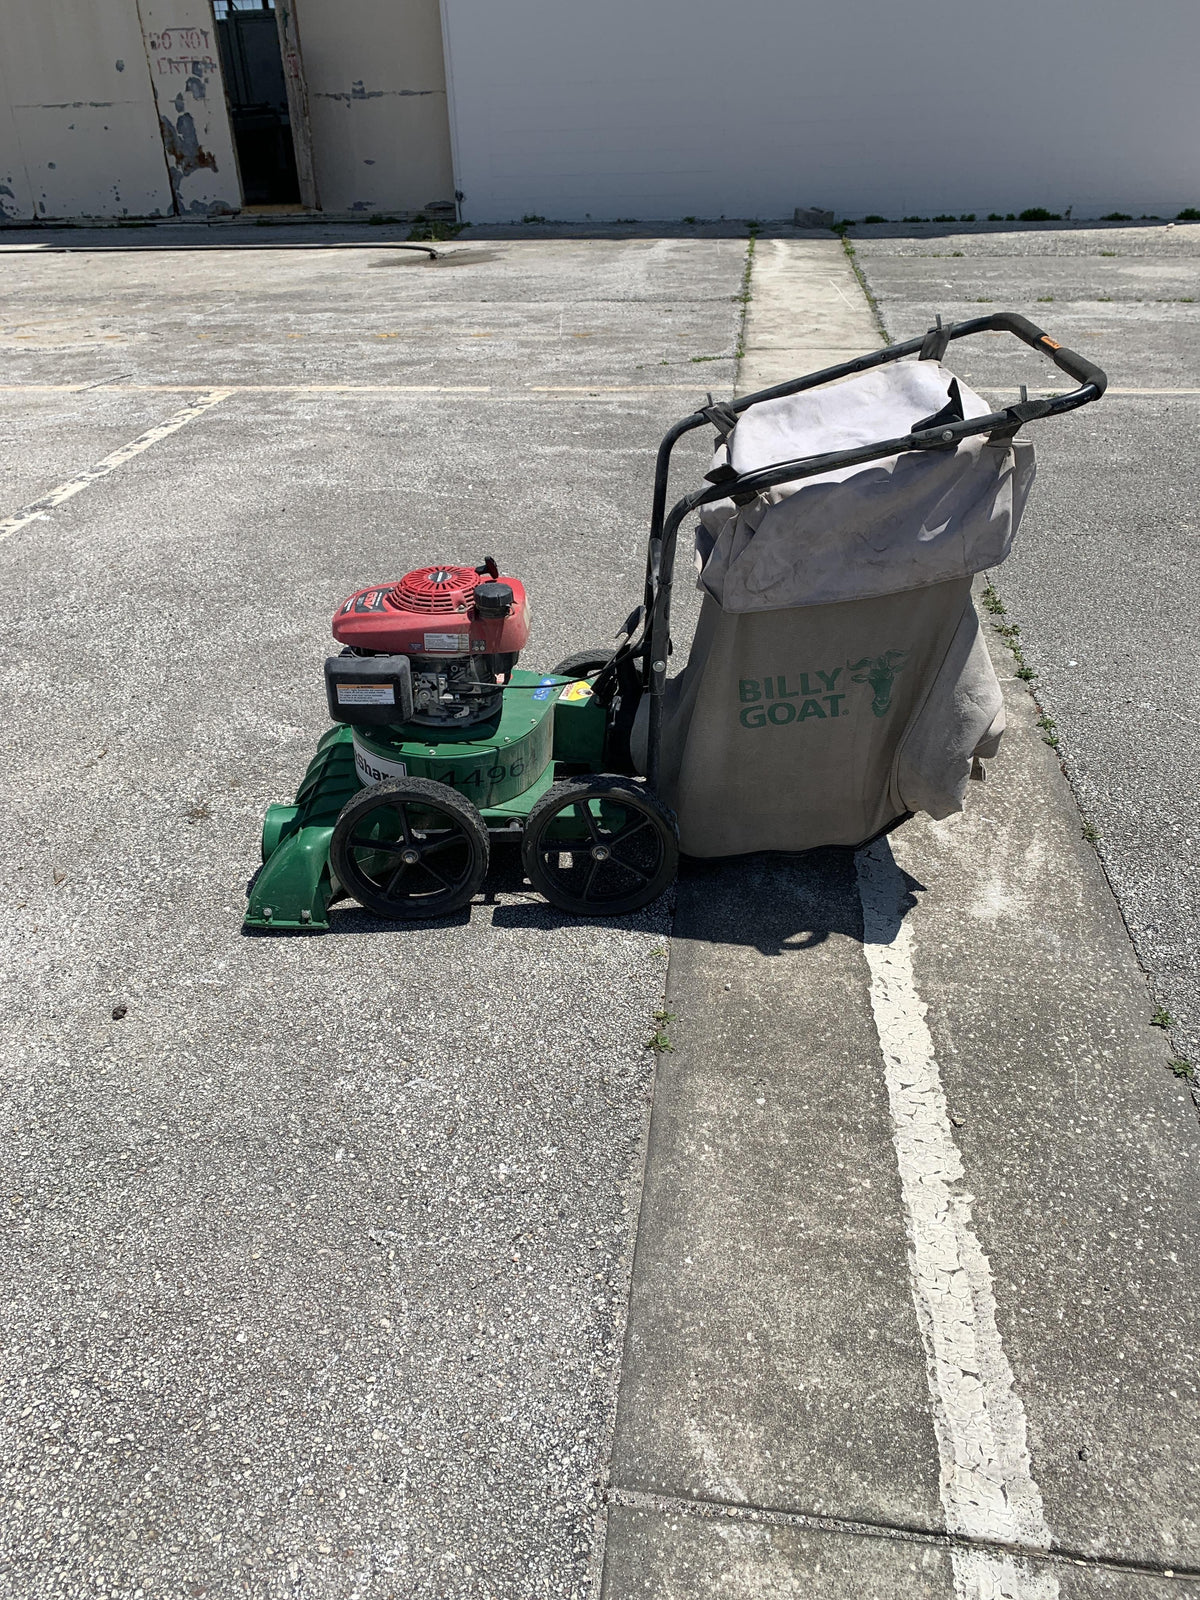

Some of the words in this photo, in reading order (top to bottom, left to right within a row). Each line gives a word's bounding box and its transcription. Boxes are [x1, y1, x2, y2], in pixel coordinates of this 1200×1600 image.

[149, 32, 172, 50] DO
[180, 30, 210, 49] NOT
[738, 667, 844, 703] BILLY
[437, 757, 524, 787] 4496
